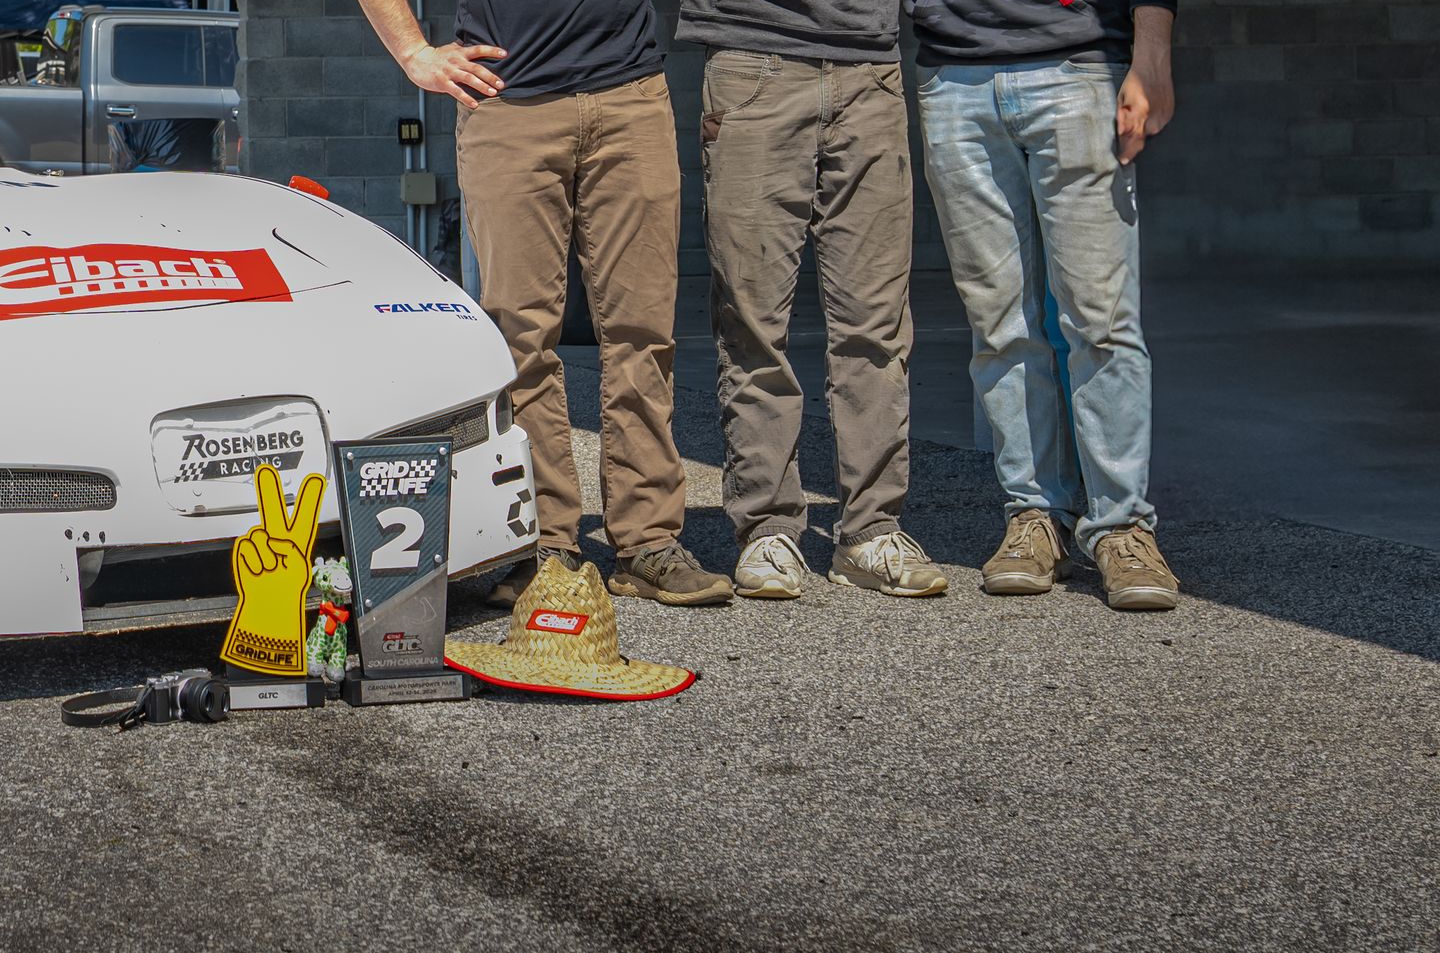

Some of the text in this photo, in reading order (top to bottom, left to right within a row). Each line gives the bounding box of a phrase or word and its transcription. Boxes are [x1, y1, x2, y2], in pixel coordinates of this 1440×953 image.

[373, 302, 471, 314] FALKEN
[219, 453, 283, 476] RACING
[359, 459, 410, 478] GRID
[387, 477, 432, 495] LIFE
[370, 506, 426, 570] 2
[535, 613, 579, 630] Eibach
[235, 644, 294, 664] GRIDLIFE
[382, 638, 422, 653] GLTC
[367, 656, 439, 668] SOUTH CAROLINA
[258, 691, 279, 700] GLTC
